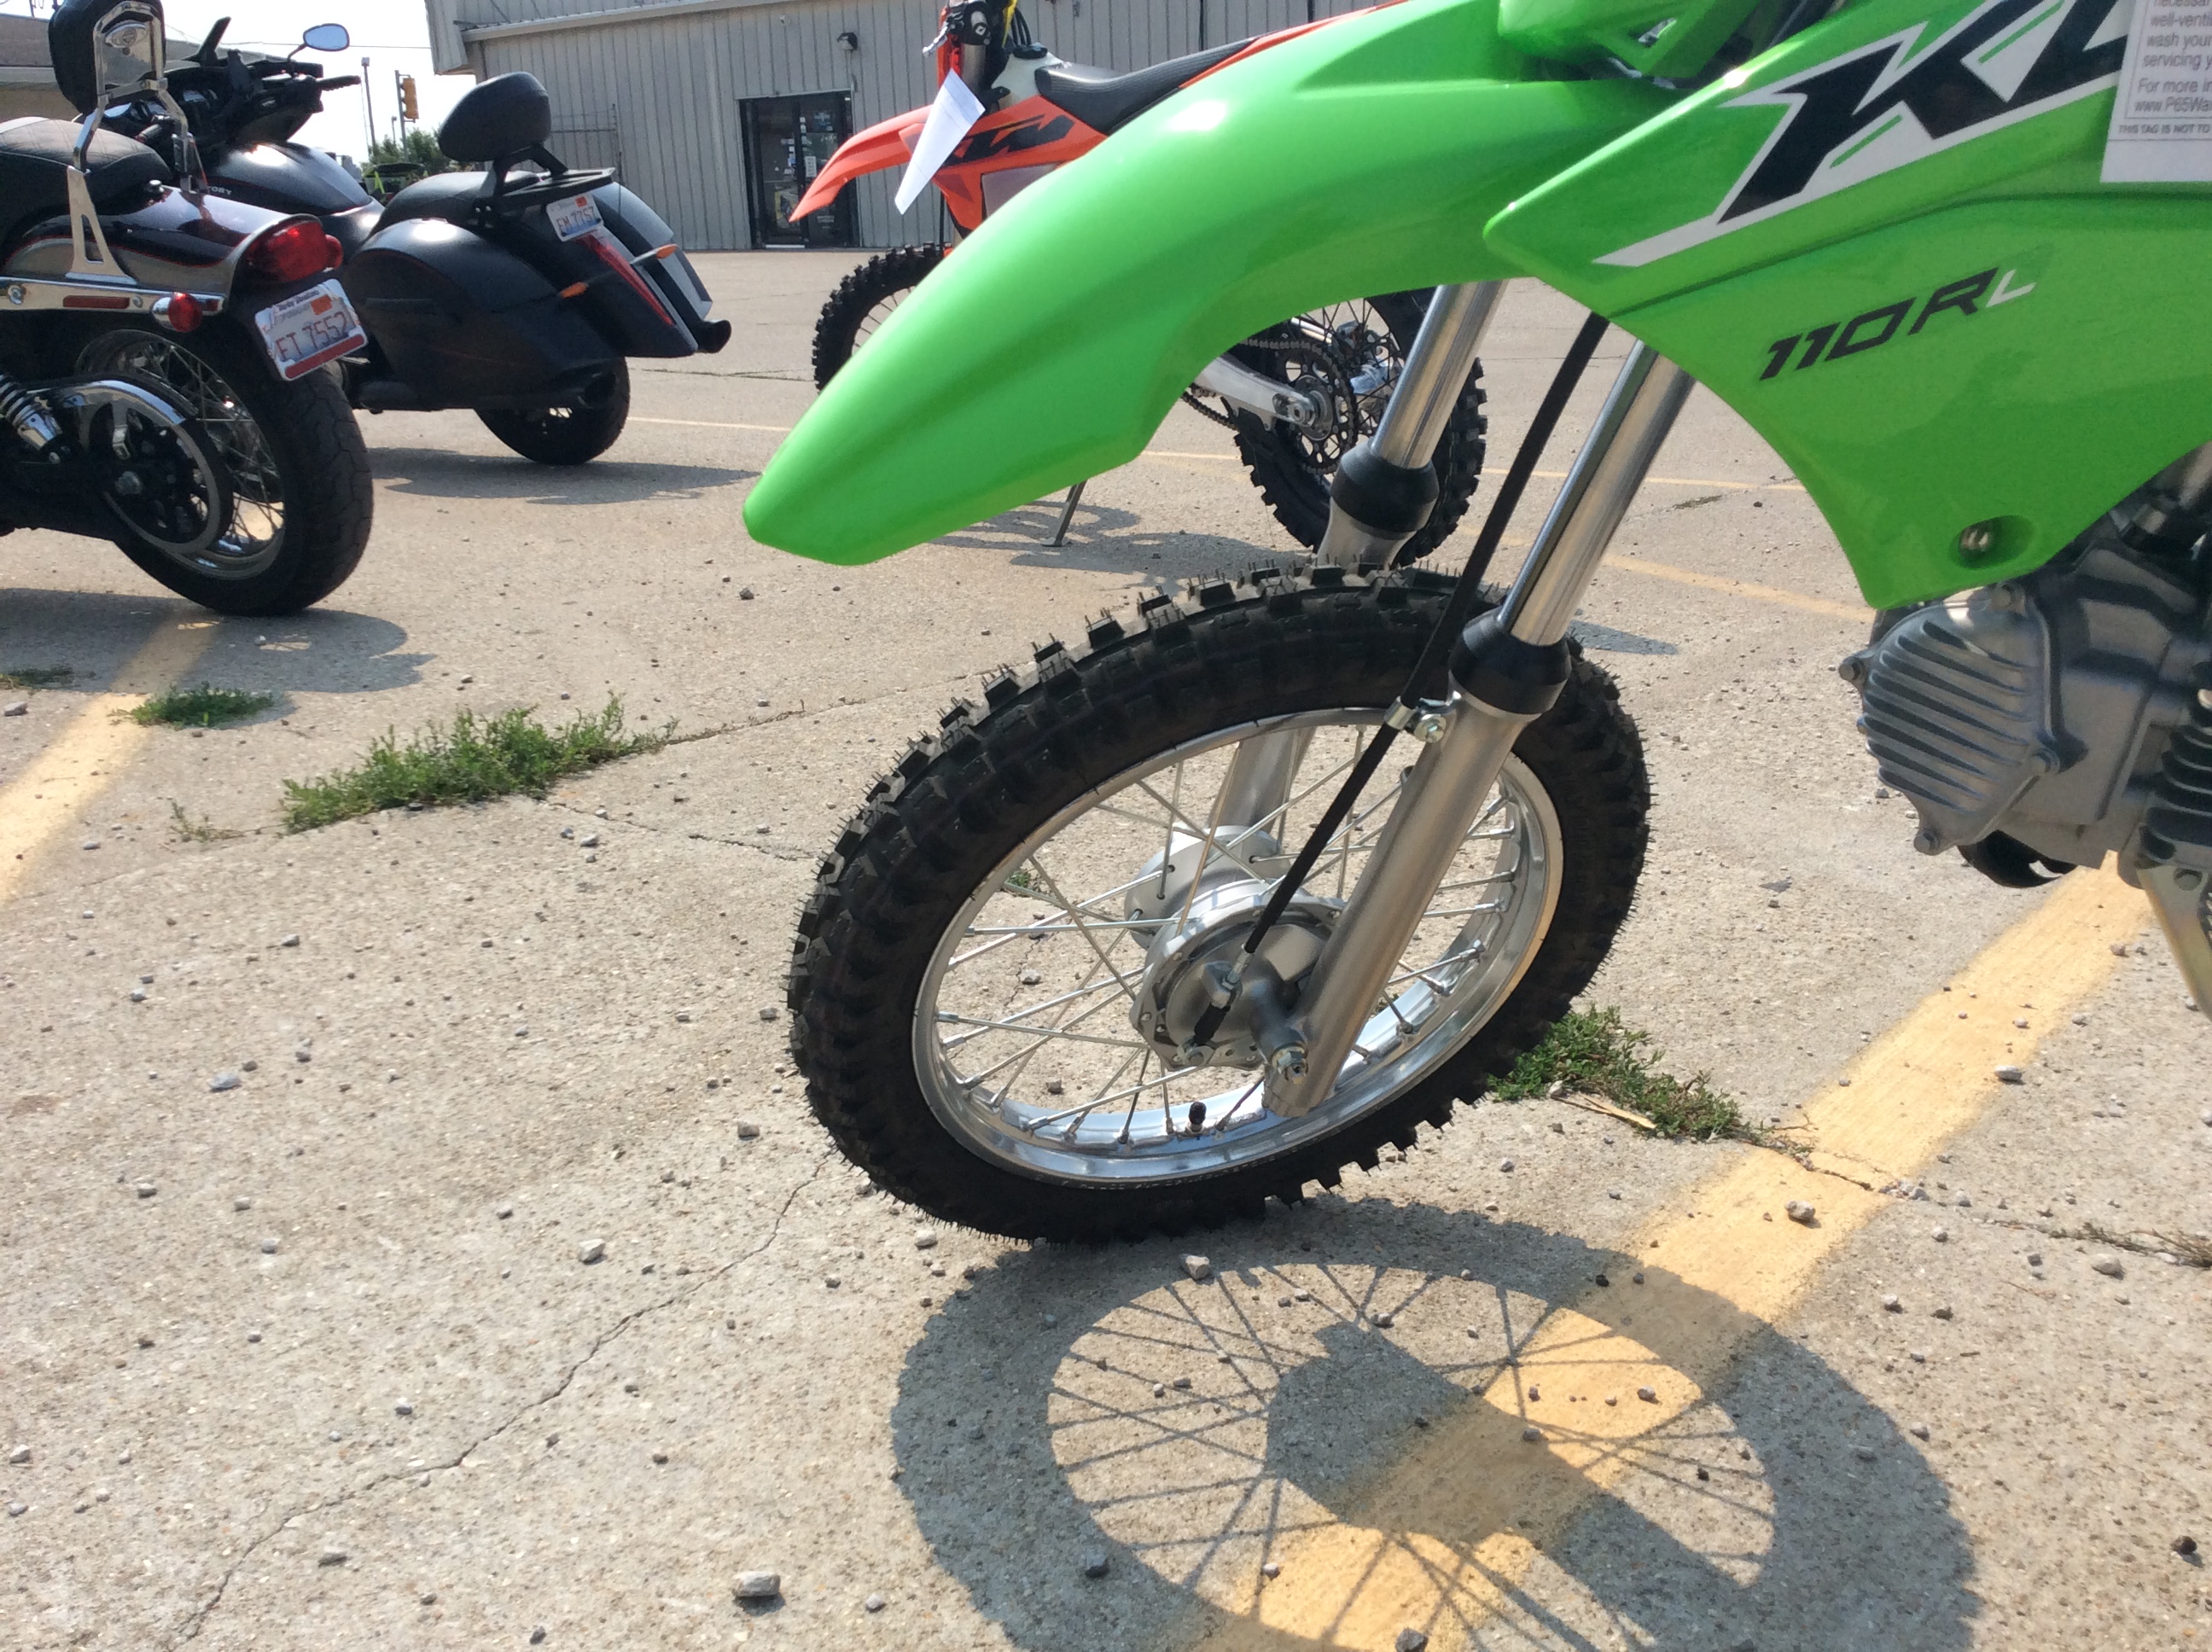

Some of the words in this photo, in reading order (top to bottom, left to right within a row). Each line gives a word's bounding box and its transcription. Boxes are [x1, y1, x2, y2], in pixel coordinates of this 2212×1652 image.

[2143, 54, 2202, 71] servicing
[2138, 78, 2160, 93] For
[2162, 81, 2197, 93] more
[2173, 124, 2194, 134] NOT
